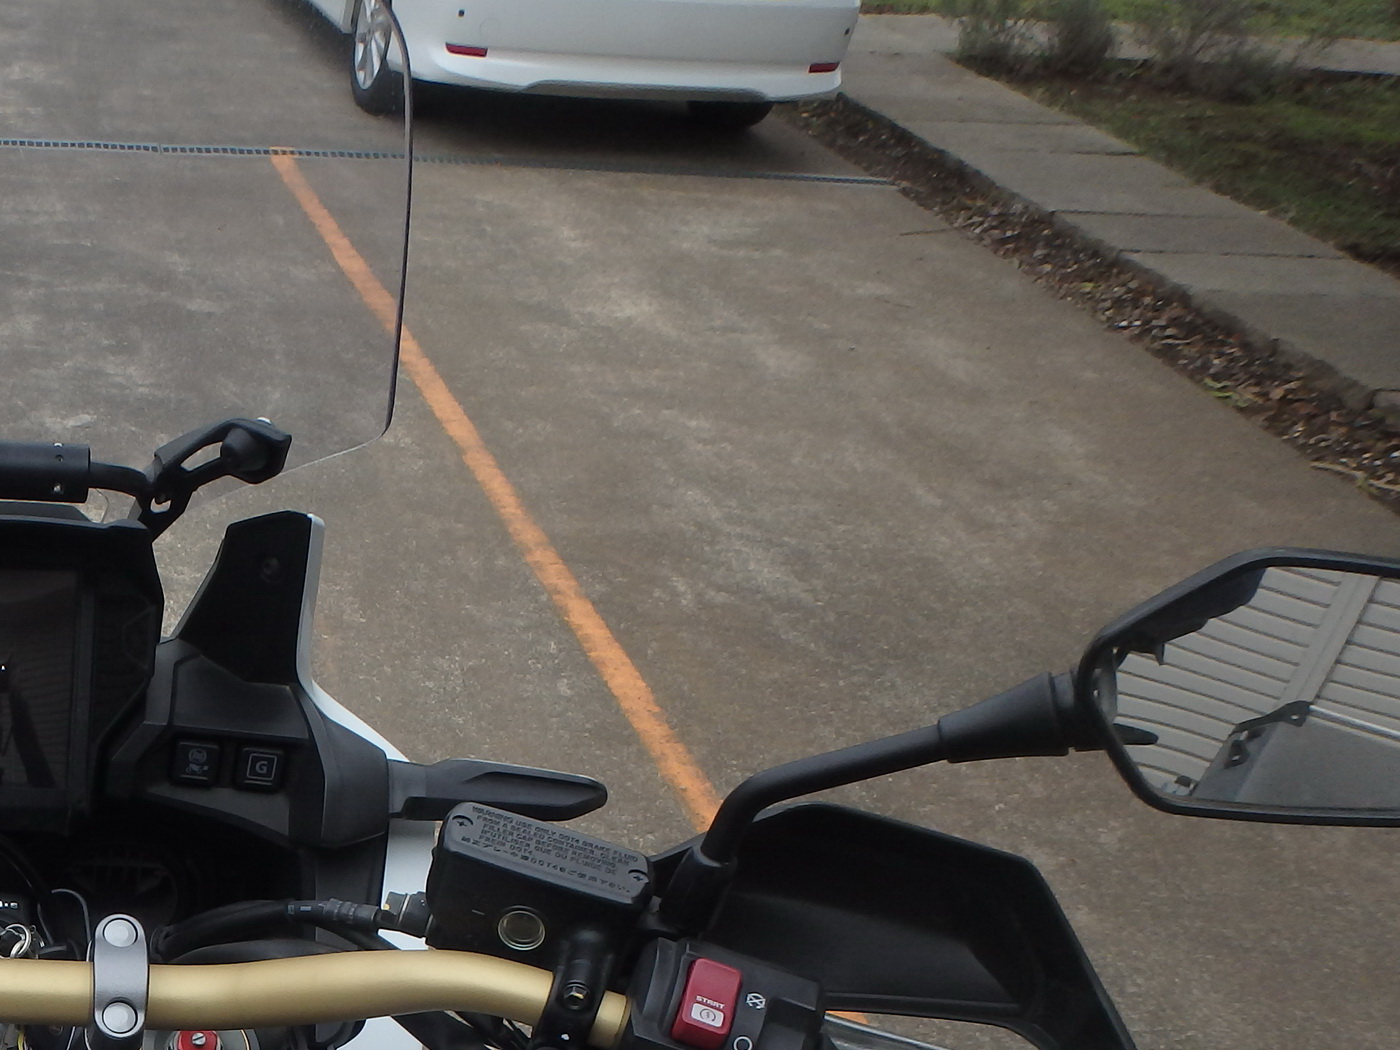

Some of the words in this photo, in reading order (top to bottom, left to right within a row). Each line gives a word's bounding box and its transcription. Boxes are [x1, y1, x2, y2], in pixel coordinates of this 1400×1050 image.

[256, 761, 267, 773] G
[515, 820, 533, 830] USE
[696, 995, 725, 1009] START
